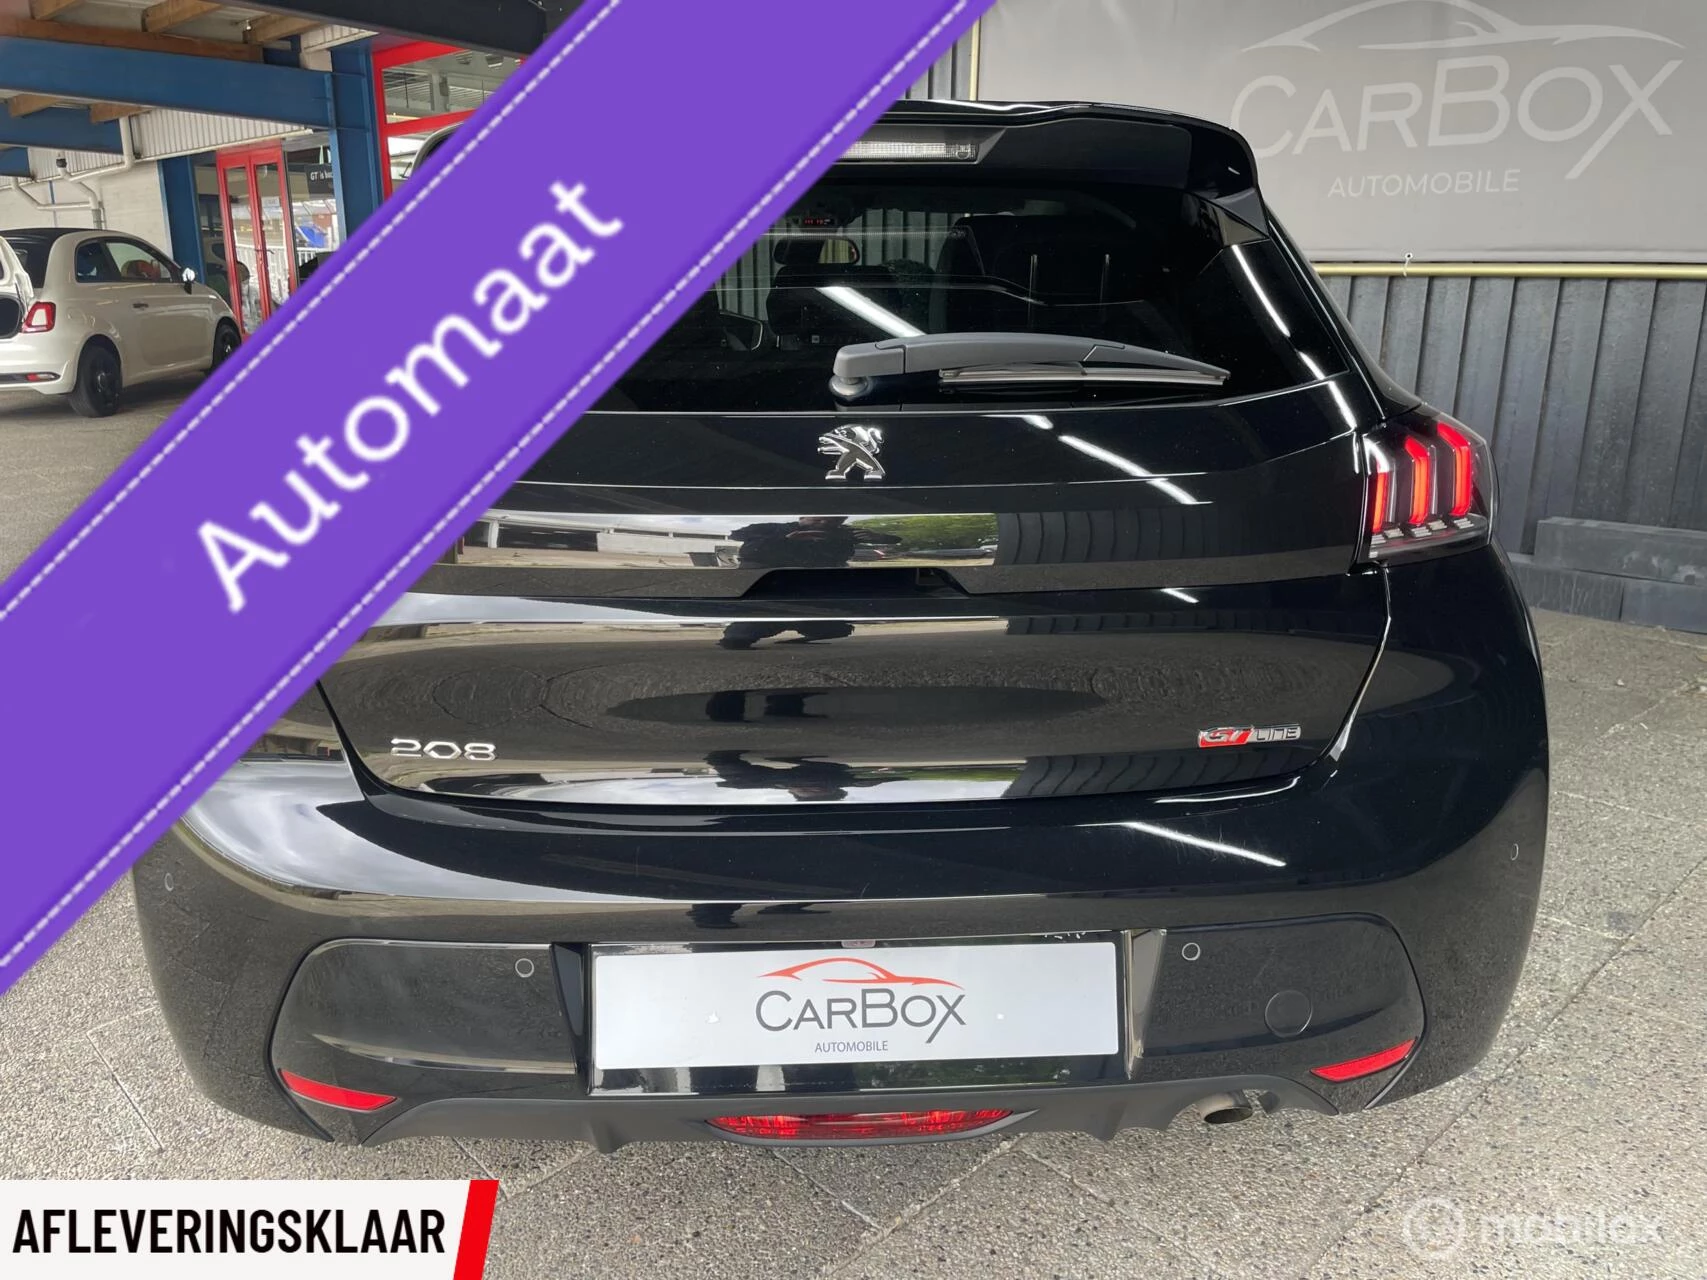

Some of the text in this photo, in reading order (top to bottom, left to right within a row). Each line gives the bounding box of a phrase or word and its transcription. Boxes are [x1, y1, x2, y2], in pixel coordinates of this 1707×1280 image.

[1231, 55, 1684, 181] CARBOX
[1328, 169, 1520, 198] AUTOMOBILE
[1204, 726, 1298, 744] GT LINE
[390, 738, 497, 761] 208
[755, 988, 967, 1044] CARBOX
[815, 1040, 889, 1053] AUTOMOBILE
